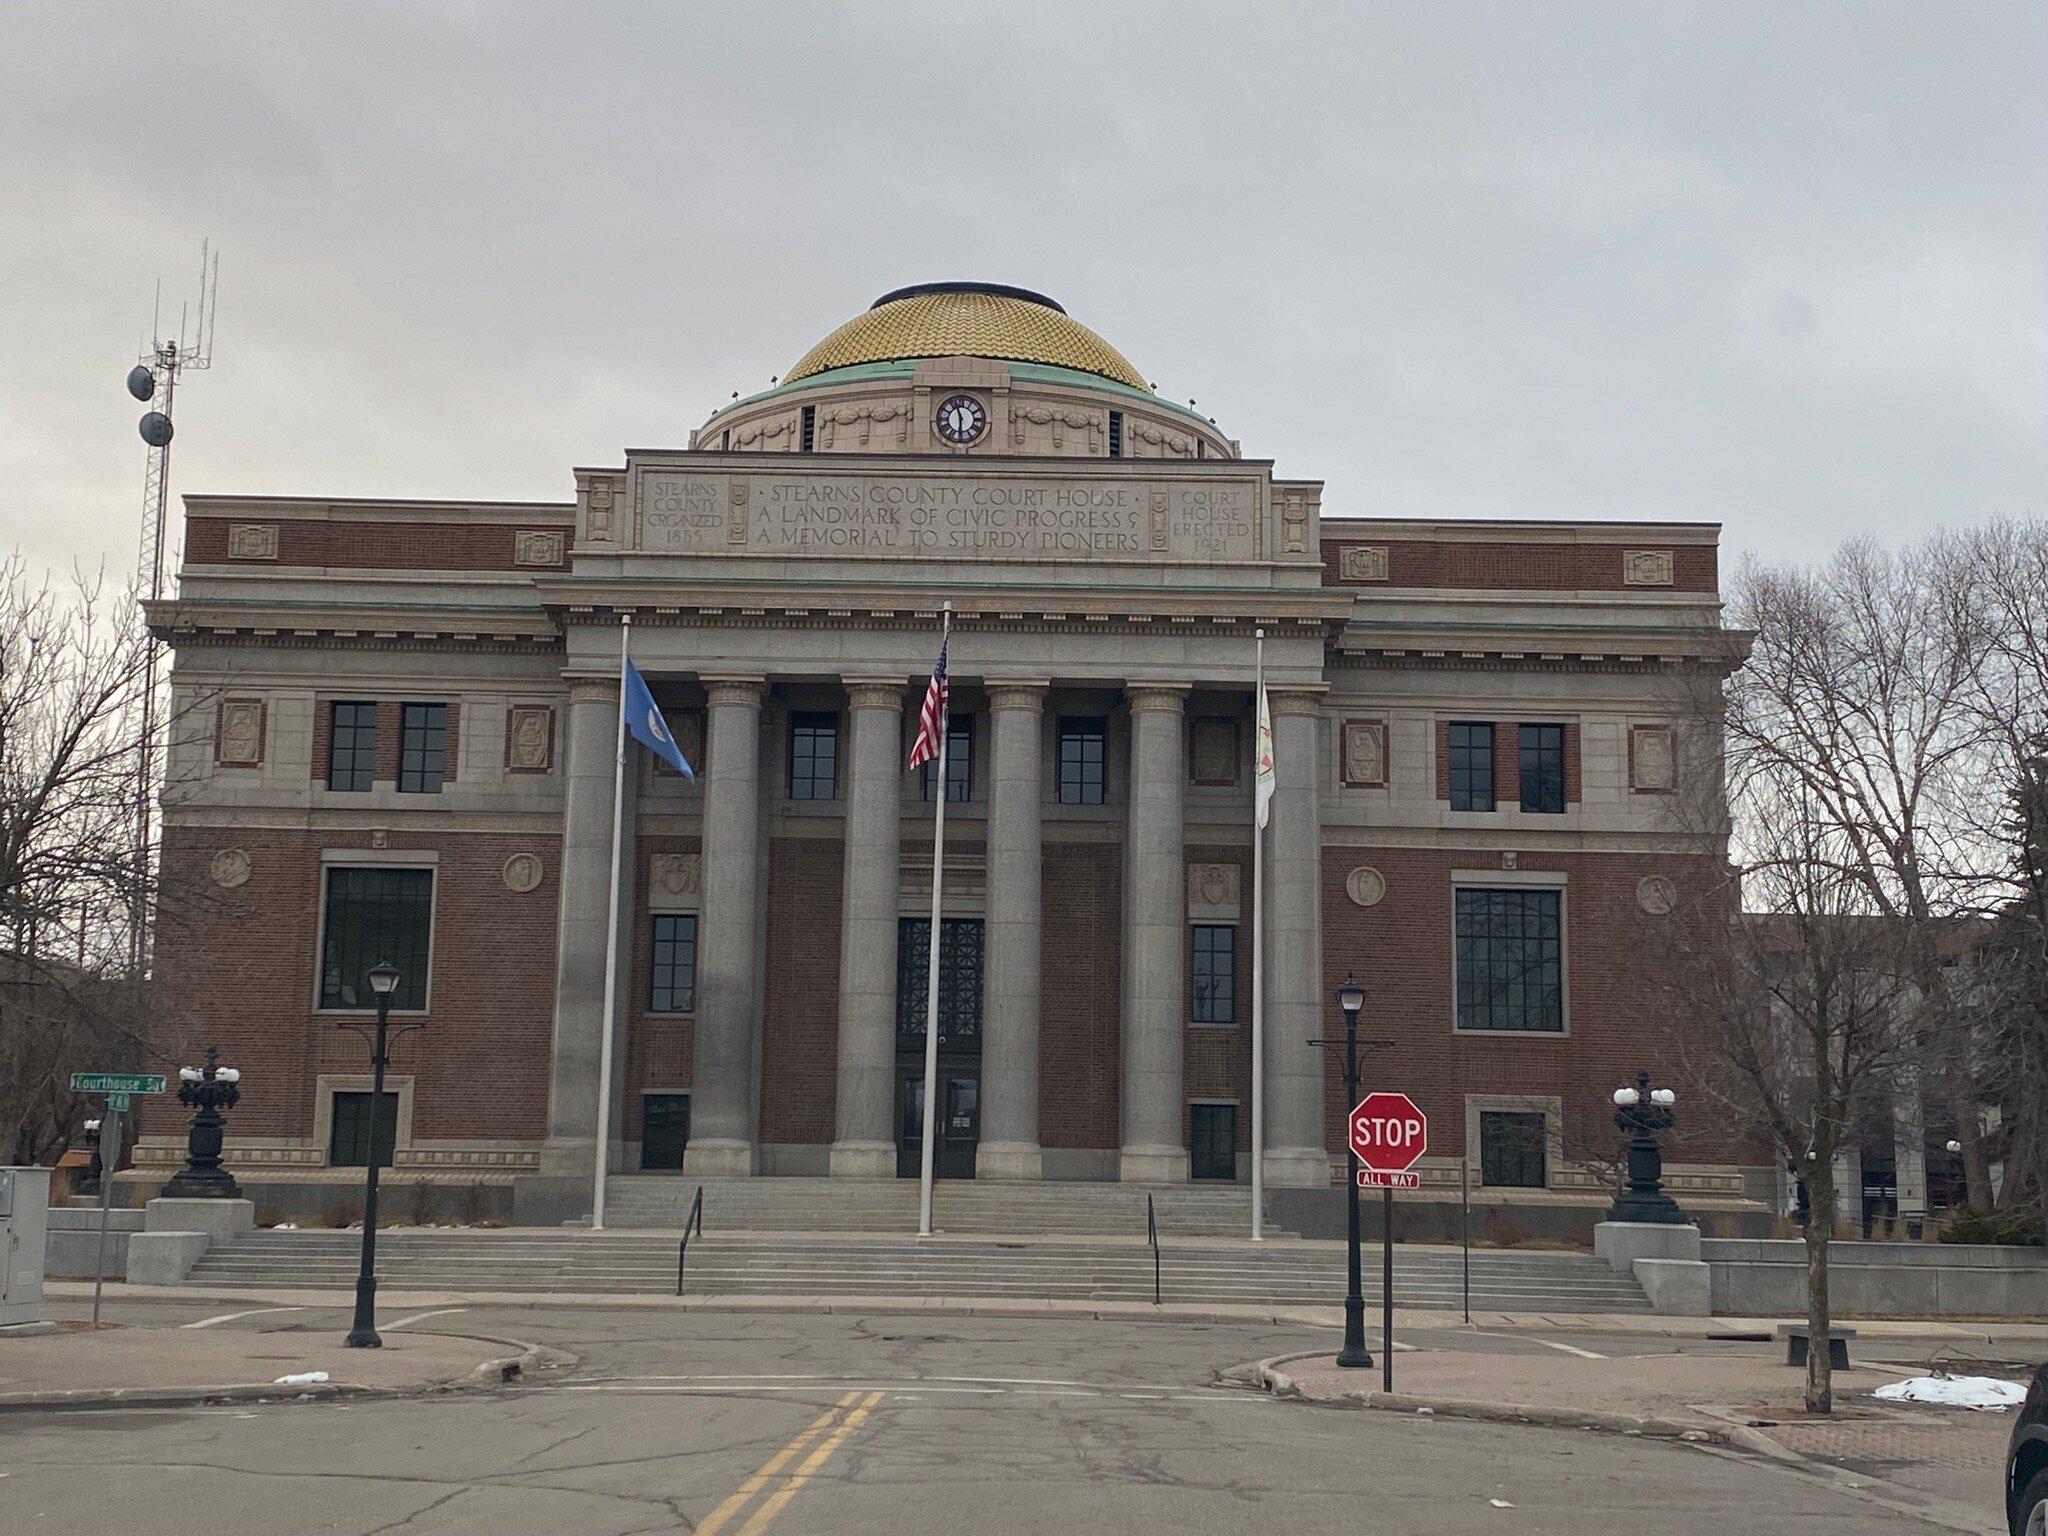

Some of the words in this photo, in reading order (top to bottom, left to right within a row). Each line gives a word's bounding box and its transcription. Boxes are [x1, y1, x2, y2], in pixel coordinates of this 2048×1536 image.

[654, 481, 718, 496] STEARNS
[770, 484, 861, 503] STEARNS
[869, 485, 963, 505] COUNTY
[972, 487, 1048, 506] COURT
[1056, 488, 1128, 507] HOUSE
[654, 497, 719, 512] COUNTY
[1181, 490, 1240, 505] COURT
[759, 506, 772, 523] A
[781, 506, 902, 525] LANDMARK
[909, 507, 938, 526] OF
[946, 508, 1007, 527] CIVIC
[1015, 509, 1121, 528] PROGRESS
[1182, 506, 1241, 521] HOUSE
[1173, 522, 1250, 537] ERECTED
[757, 527, 772, 545] A
[781, 527, 896, 546] MEMORIAL
[907, 529, 939, 548] TO
[948, 530, 1029, 549] STURDY
[1040, 531, 1140, 551] PIONEERS
[1193, 538, 1228, 555] 1921
[76, 1075, 140, 1090] Courthouse
[1355, 1117, 1421, 1147] STOP
[1362, 1173, 1384, 1185] ALL
[1390, 1174, 1414, 1187] WAY
